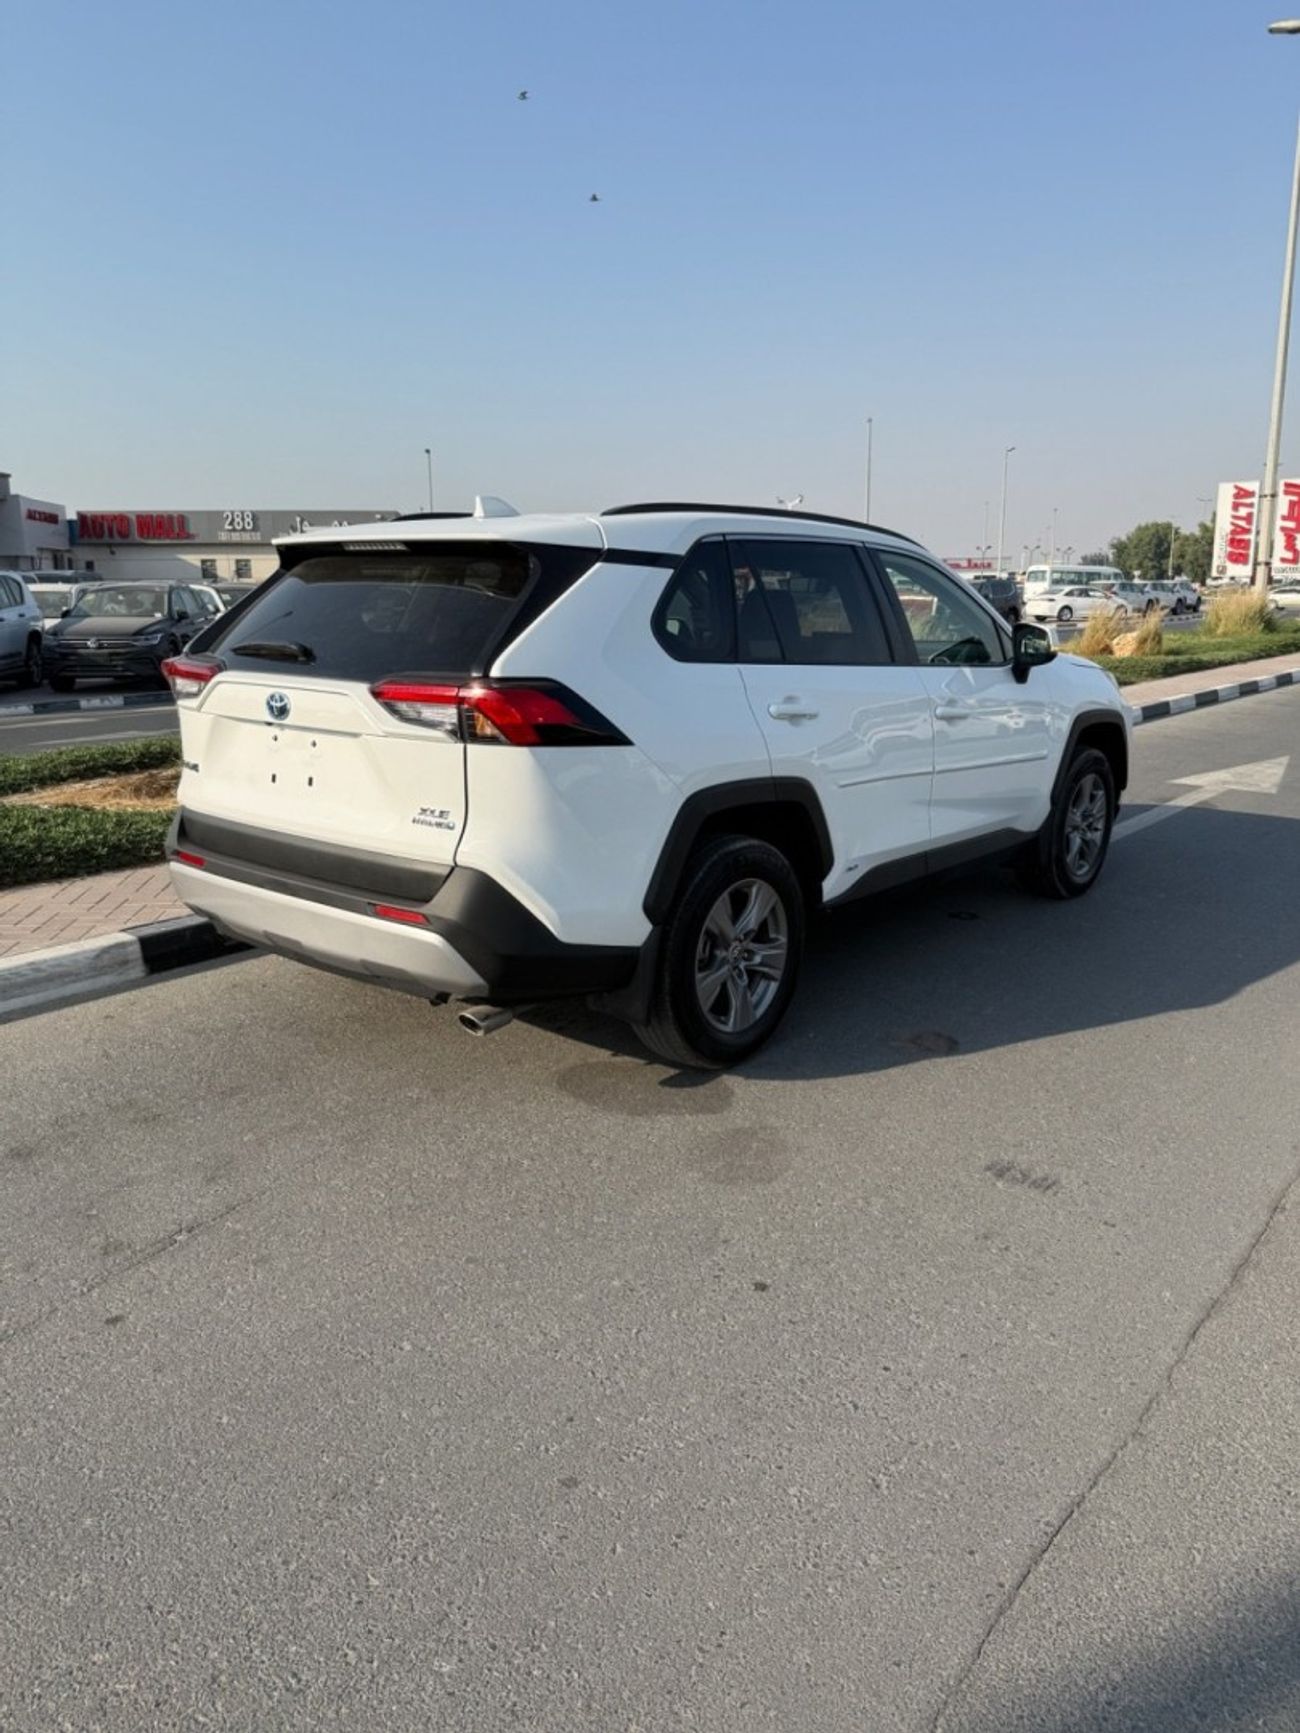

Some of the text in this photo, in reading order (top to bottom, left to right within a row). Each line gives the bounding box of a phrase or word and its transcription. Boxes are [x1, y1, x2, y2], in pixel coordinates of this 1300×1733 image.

[78, 513, 130, 539] AUTO
[134, 513, 195, 540] MALL
[223, 511, 253, 530] 288
